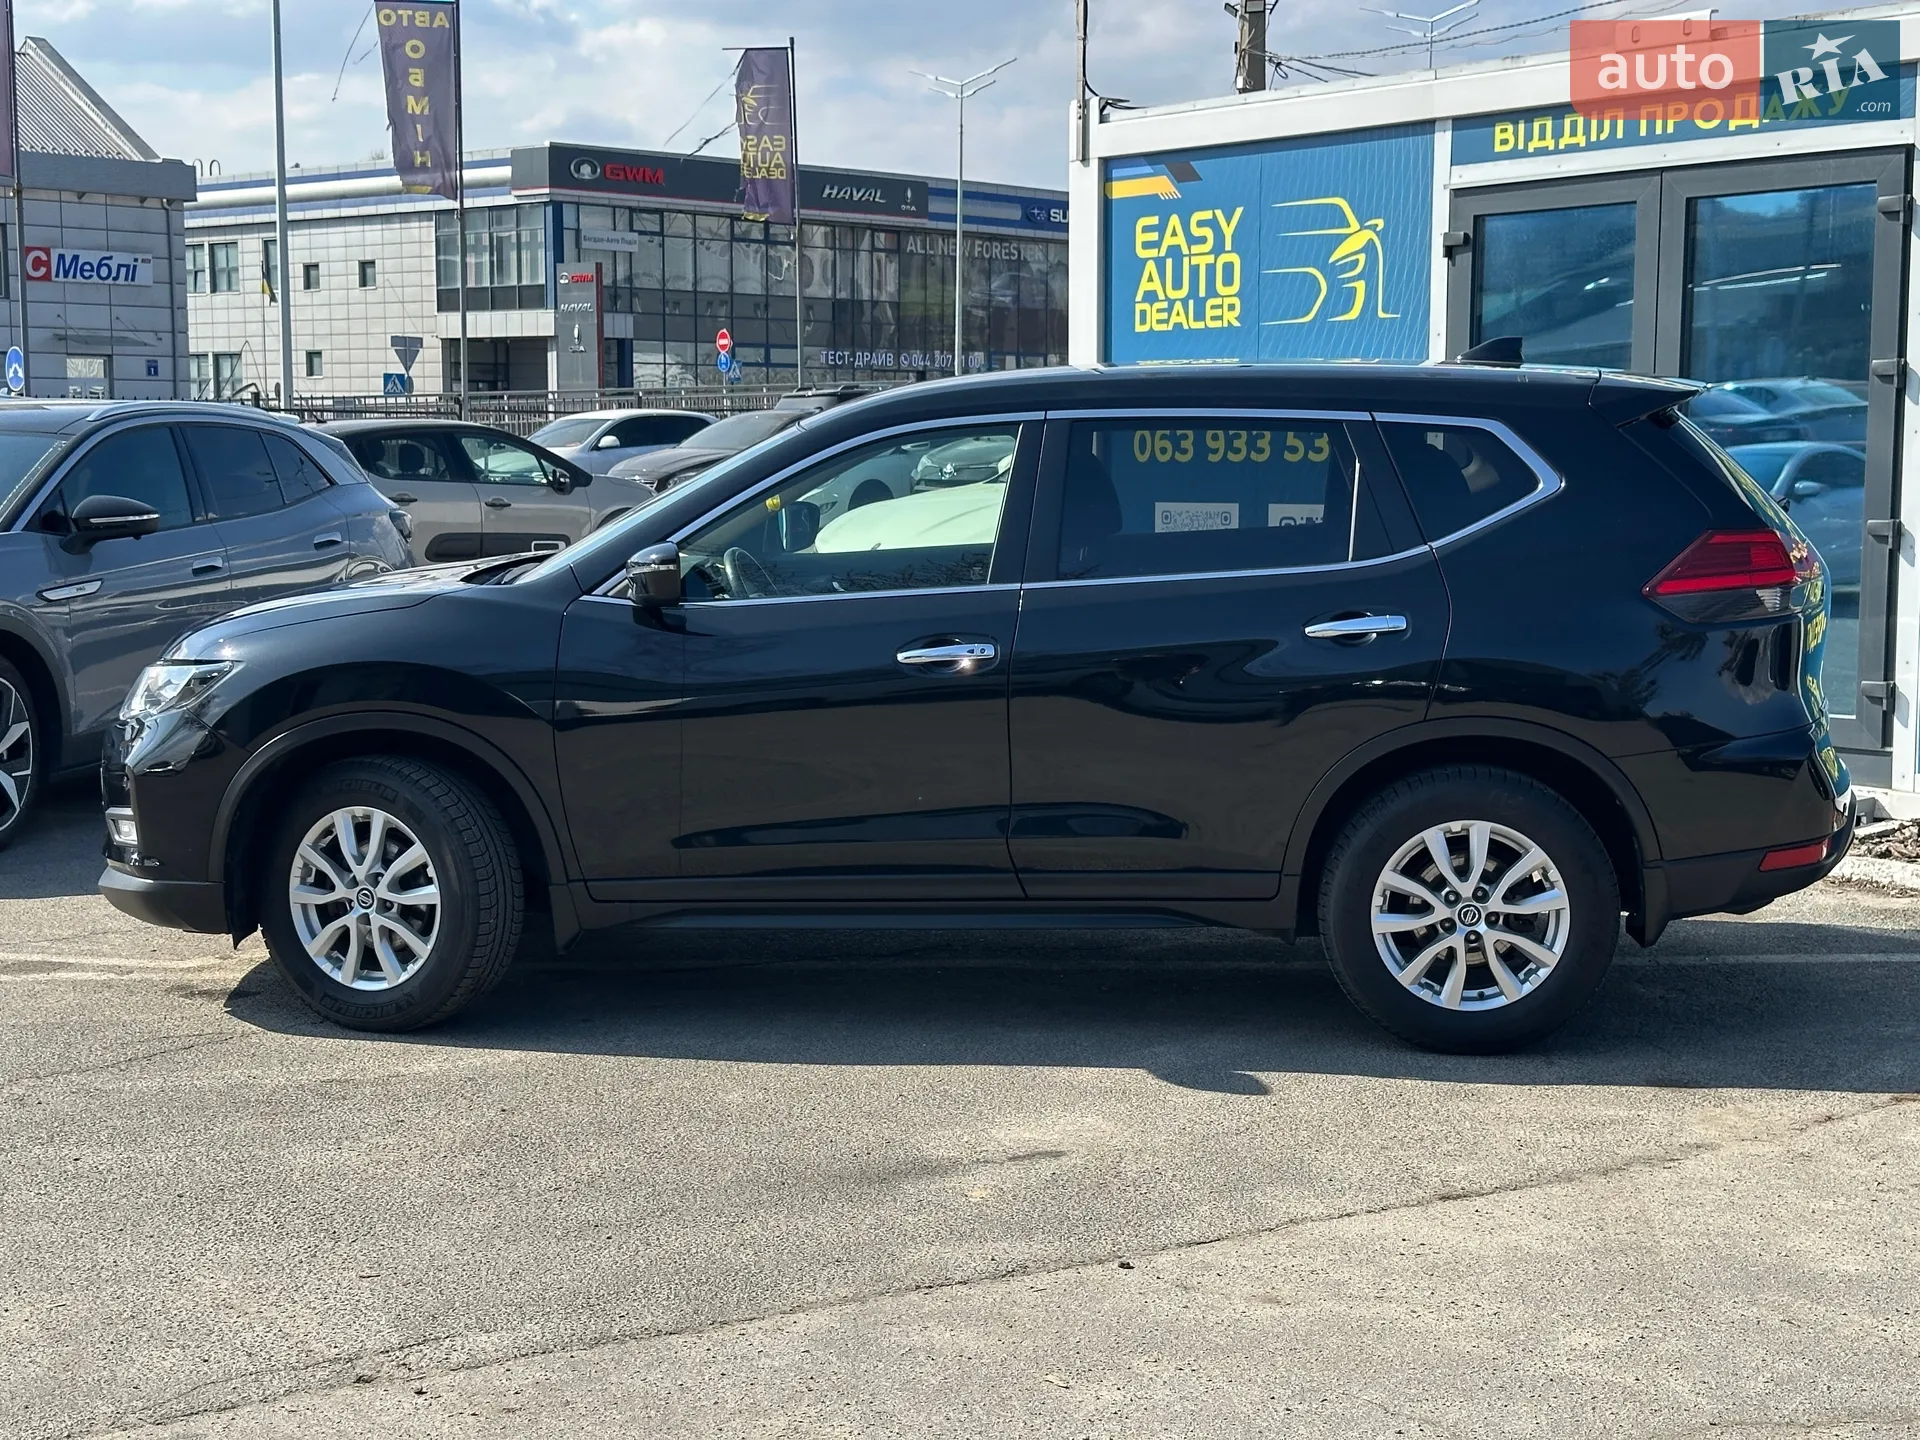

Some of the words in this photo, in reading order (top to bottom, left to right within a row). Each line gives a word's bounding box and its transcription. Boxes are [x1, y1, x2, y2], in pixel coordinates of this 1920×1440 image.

[1493, 107, 1625, 154] ВІДДІЛ
[603, 164, 665, 185] GWM
[822, 185, 887, 203] HAVAL
[1049, 208, 1069, 223] SU
[907, 235, 934, 254] ALL
[1135, 206, 1244, 259] EASY
[54, 253, 139, 283] Меблі
[1135, 252, 1241, 302] AUTO
[560, 302, 594, 313] HAVAL
[1135, 296, 1242, 332] DEALER
[1133, 429, 1195, 464] 063
[1205, 429, 1272, 464] 933
[1283, 430, 1330, 464] 53
